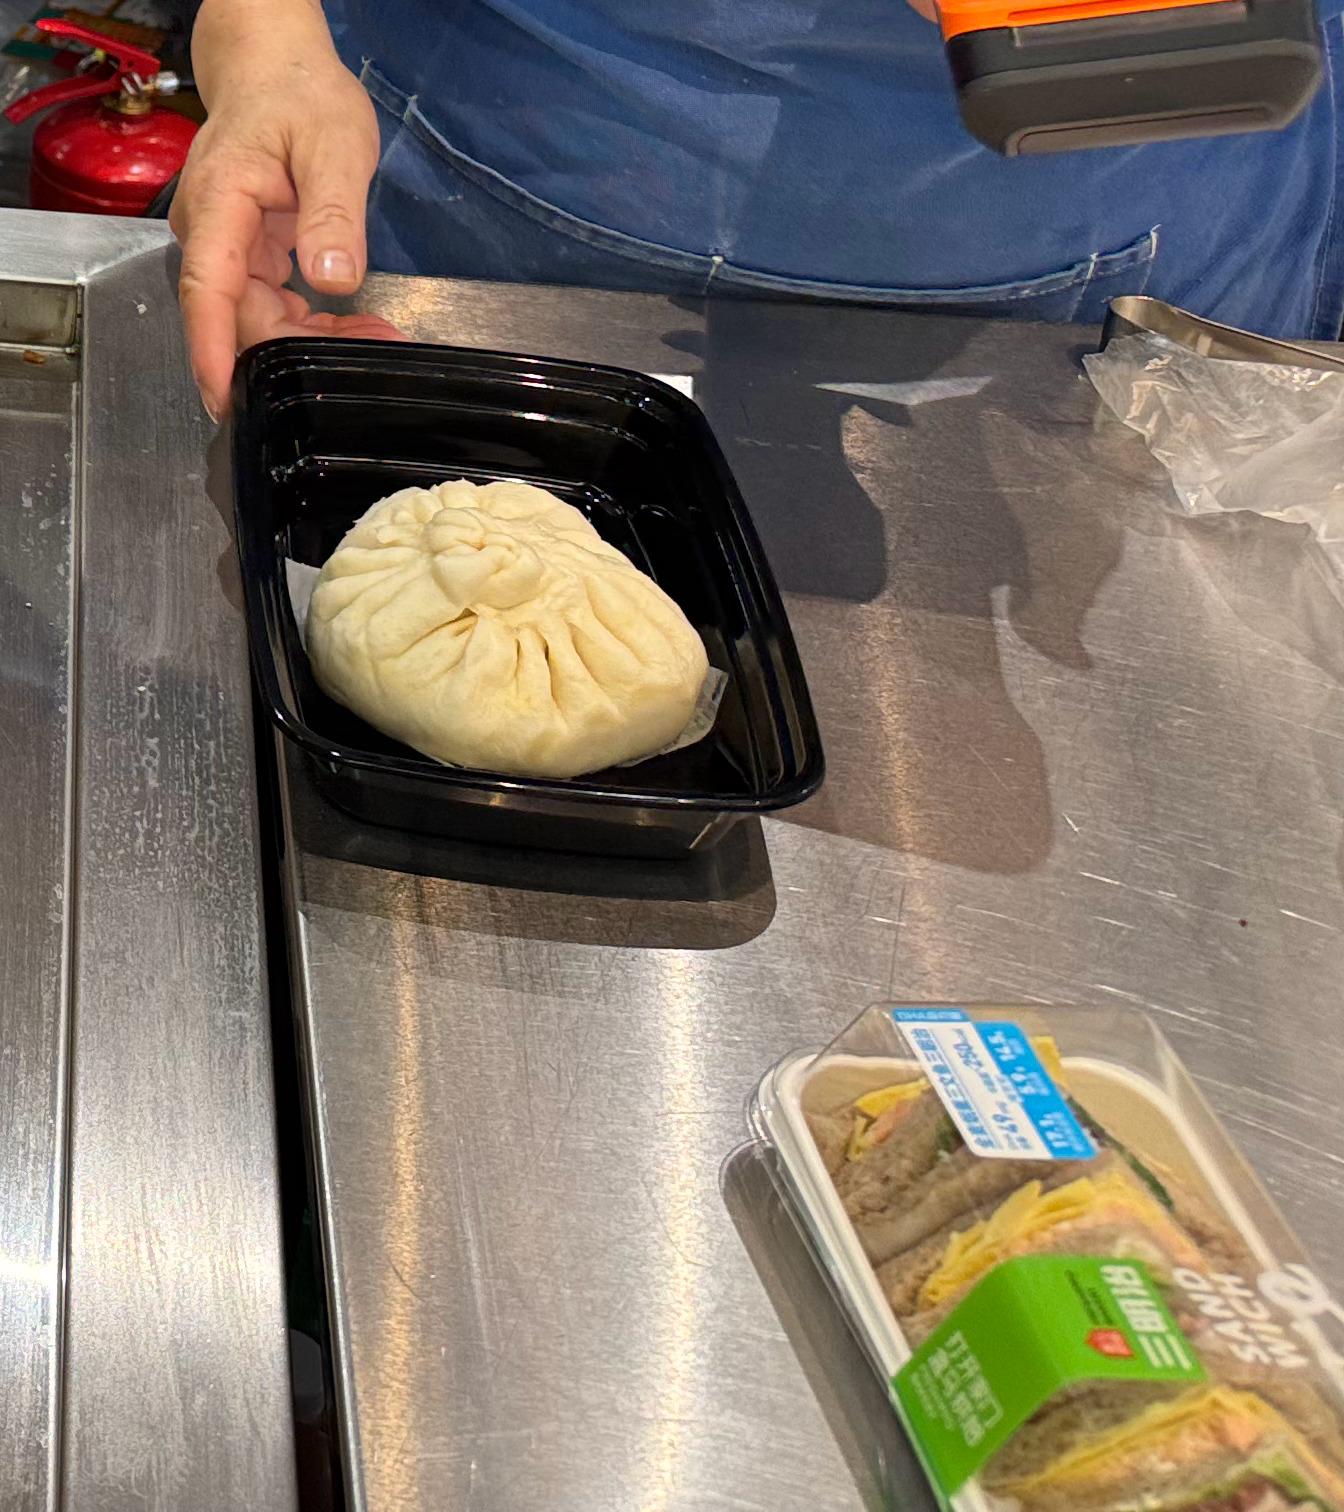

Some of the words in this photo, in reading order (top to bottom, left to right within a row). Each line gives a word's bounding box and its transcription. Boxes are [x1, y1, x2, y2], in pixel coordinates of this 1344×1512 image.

[1100, 1263, 1194, 1371] 三明治
[1172, 1267, 1272, 1365] SAND
[1208, 1271, 1309, 1369] WICH
